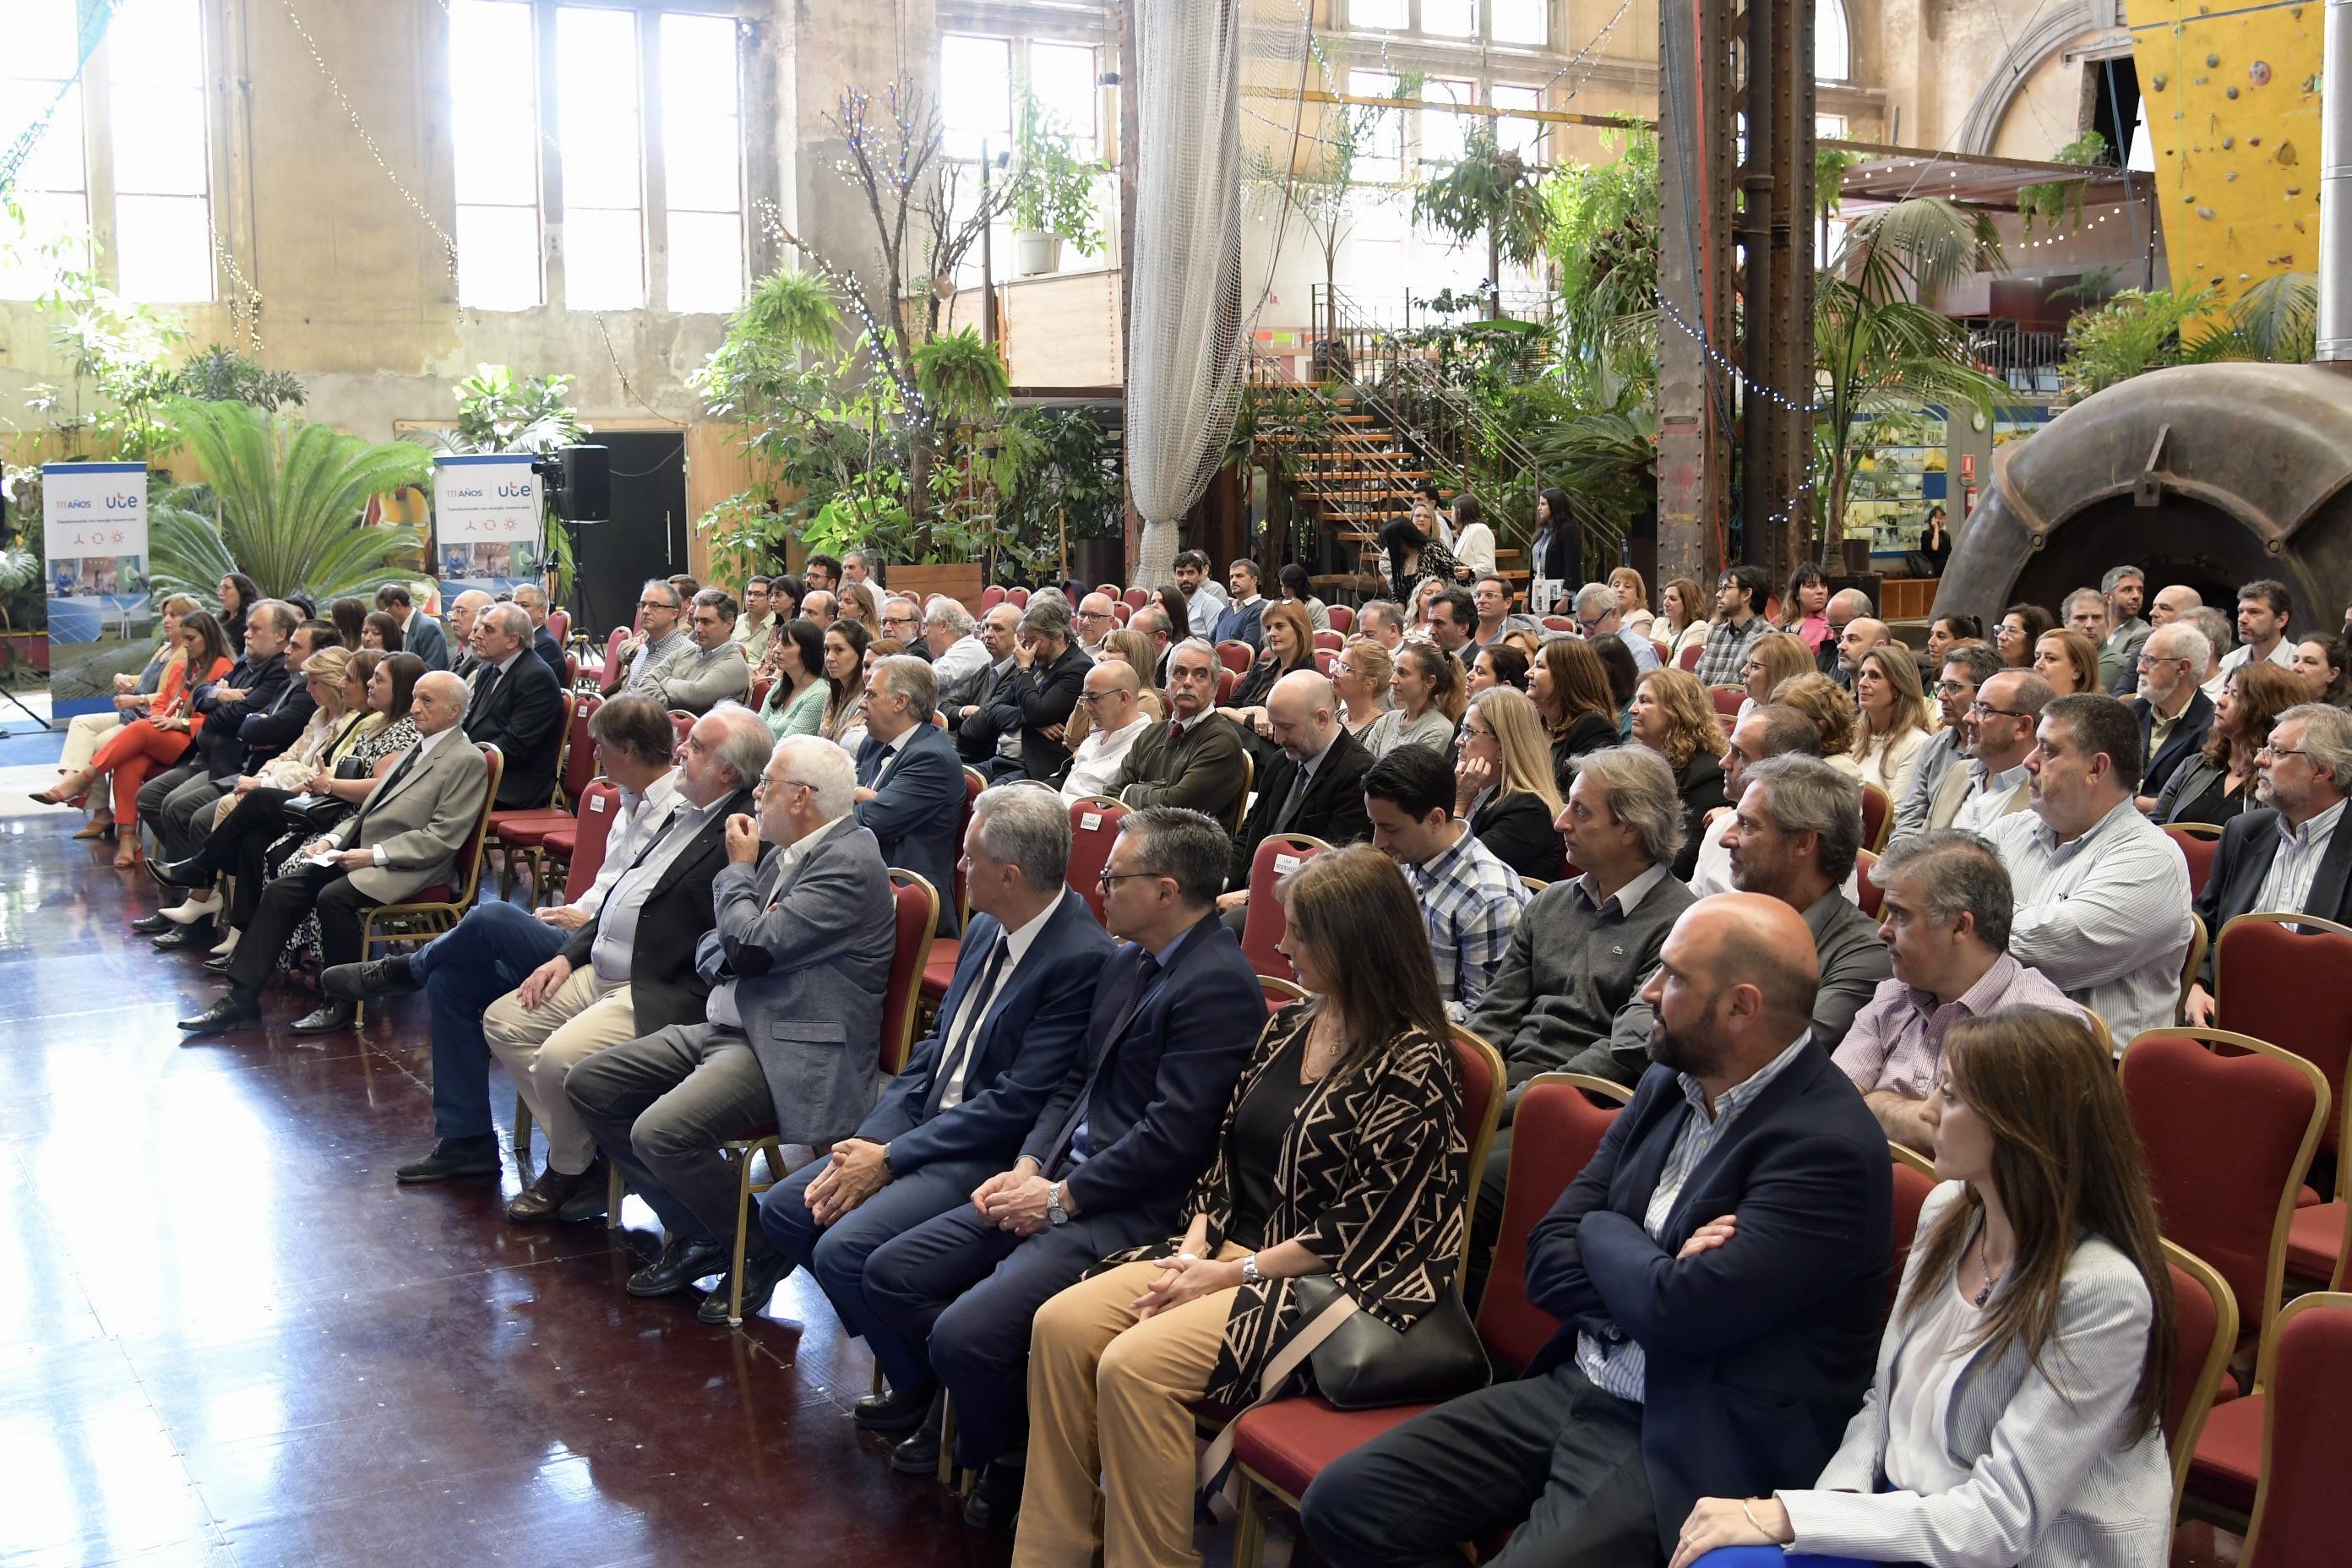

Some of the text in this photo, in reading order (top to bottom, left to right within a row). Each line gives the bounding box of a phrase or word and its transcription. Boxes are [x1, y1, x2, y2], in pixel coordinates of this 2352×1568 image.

[459, 488, 482, 497] AÑOS
[498, 482, 531, 497] ute
[68, 498, 91, 508] AÑOS
[106, 493, 138, 509] ute
